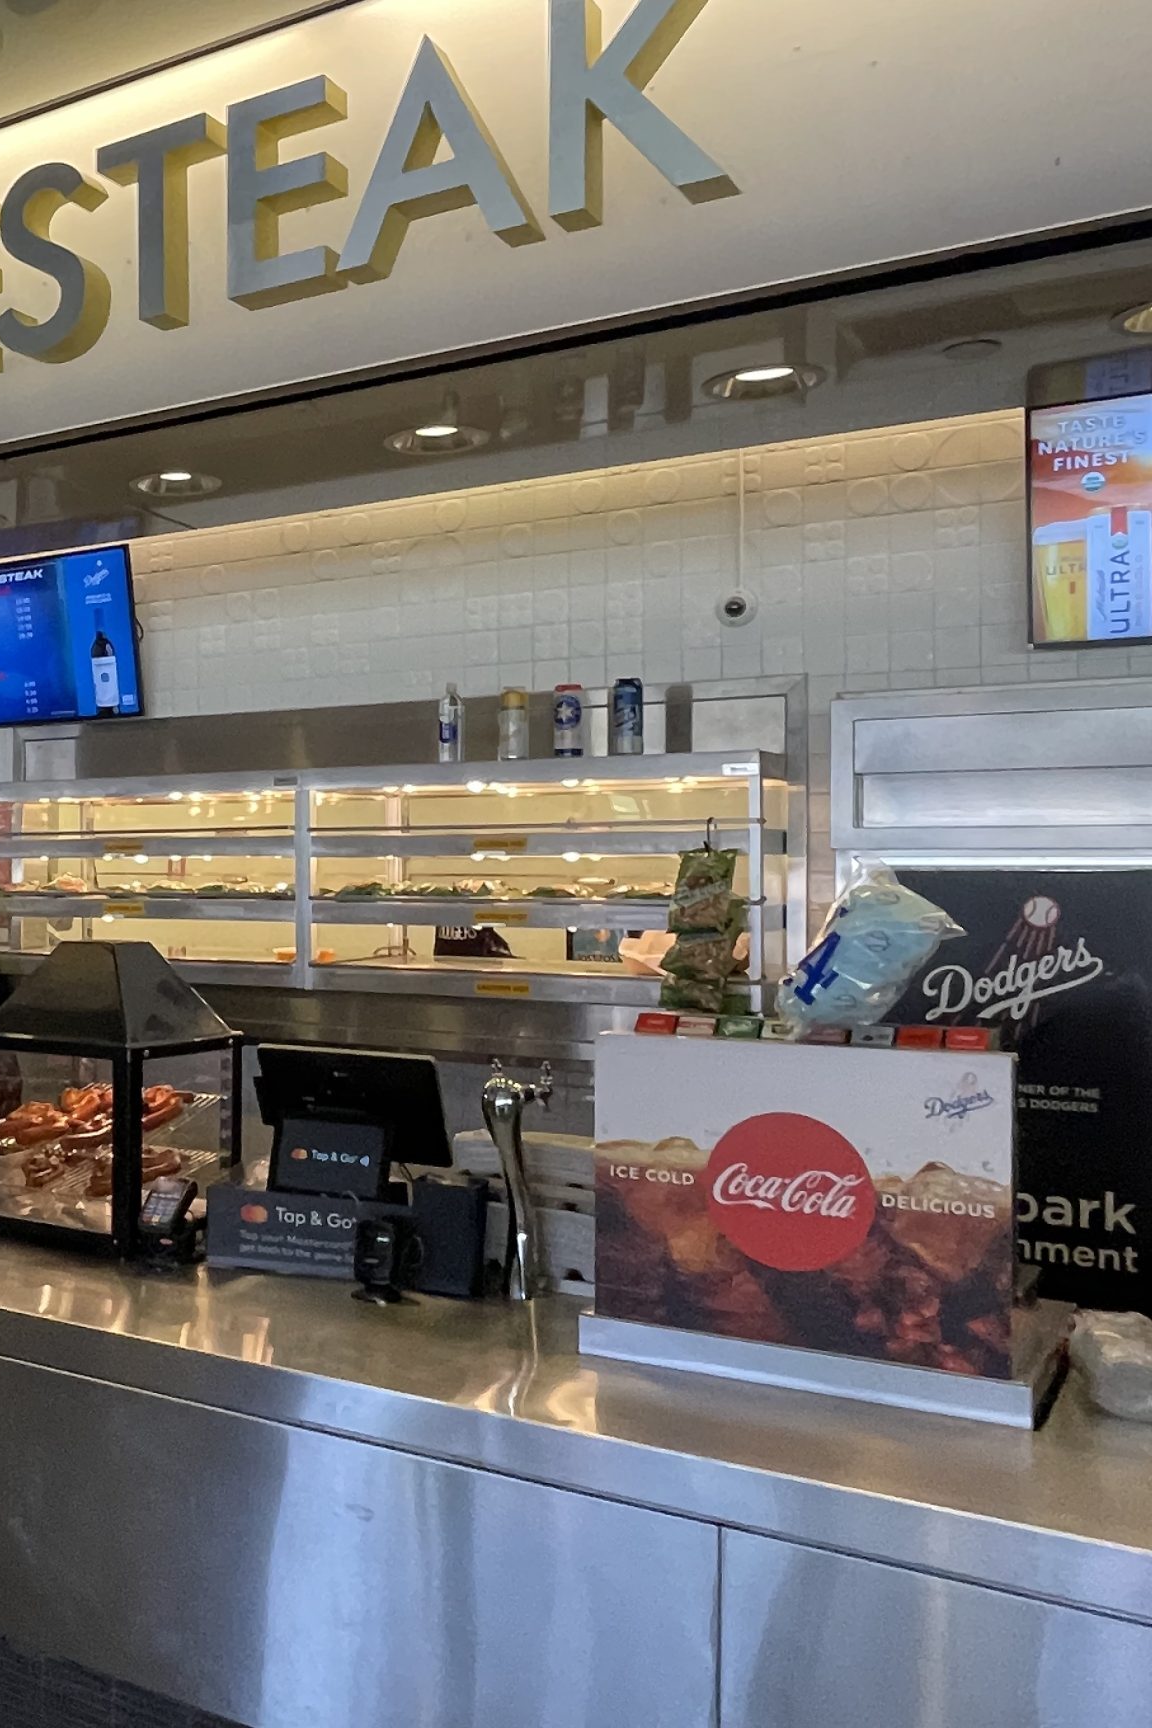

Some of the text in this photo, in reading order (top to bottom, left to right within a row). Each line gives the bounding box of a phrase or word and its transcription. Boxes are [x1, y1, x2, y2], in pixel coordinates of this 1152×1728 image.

[1057, 415, 1125, 433] TASTE
[1053, 450, 1129, 472] FINEST
[1109, 550, 1131, 634] ULTRA
[923, 937, 1104, 1021] Dodgers
[1049, 1086, 1069, 1096] OF
[1073, 1087, 1100, 1099] THE
[924, 1089, 995, 1119] Dodgers
[1030, 1099, 1098, 1113] DODGERS
[610, 1164, 695, 1186] ICE COLD
[712, 1162, 865, 1219] Coca-Cola
[275, 1206, 306, 1227] Tap
[310, 1210, 323, 1226] &
[882, 1194, 996, 1219] DELICIOUS
